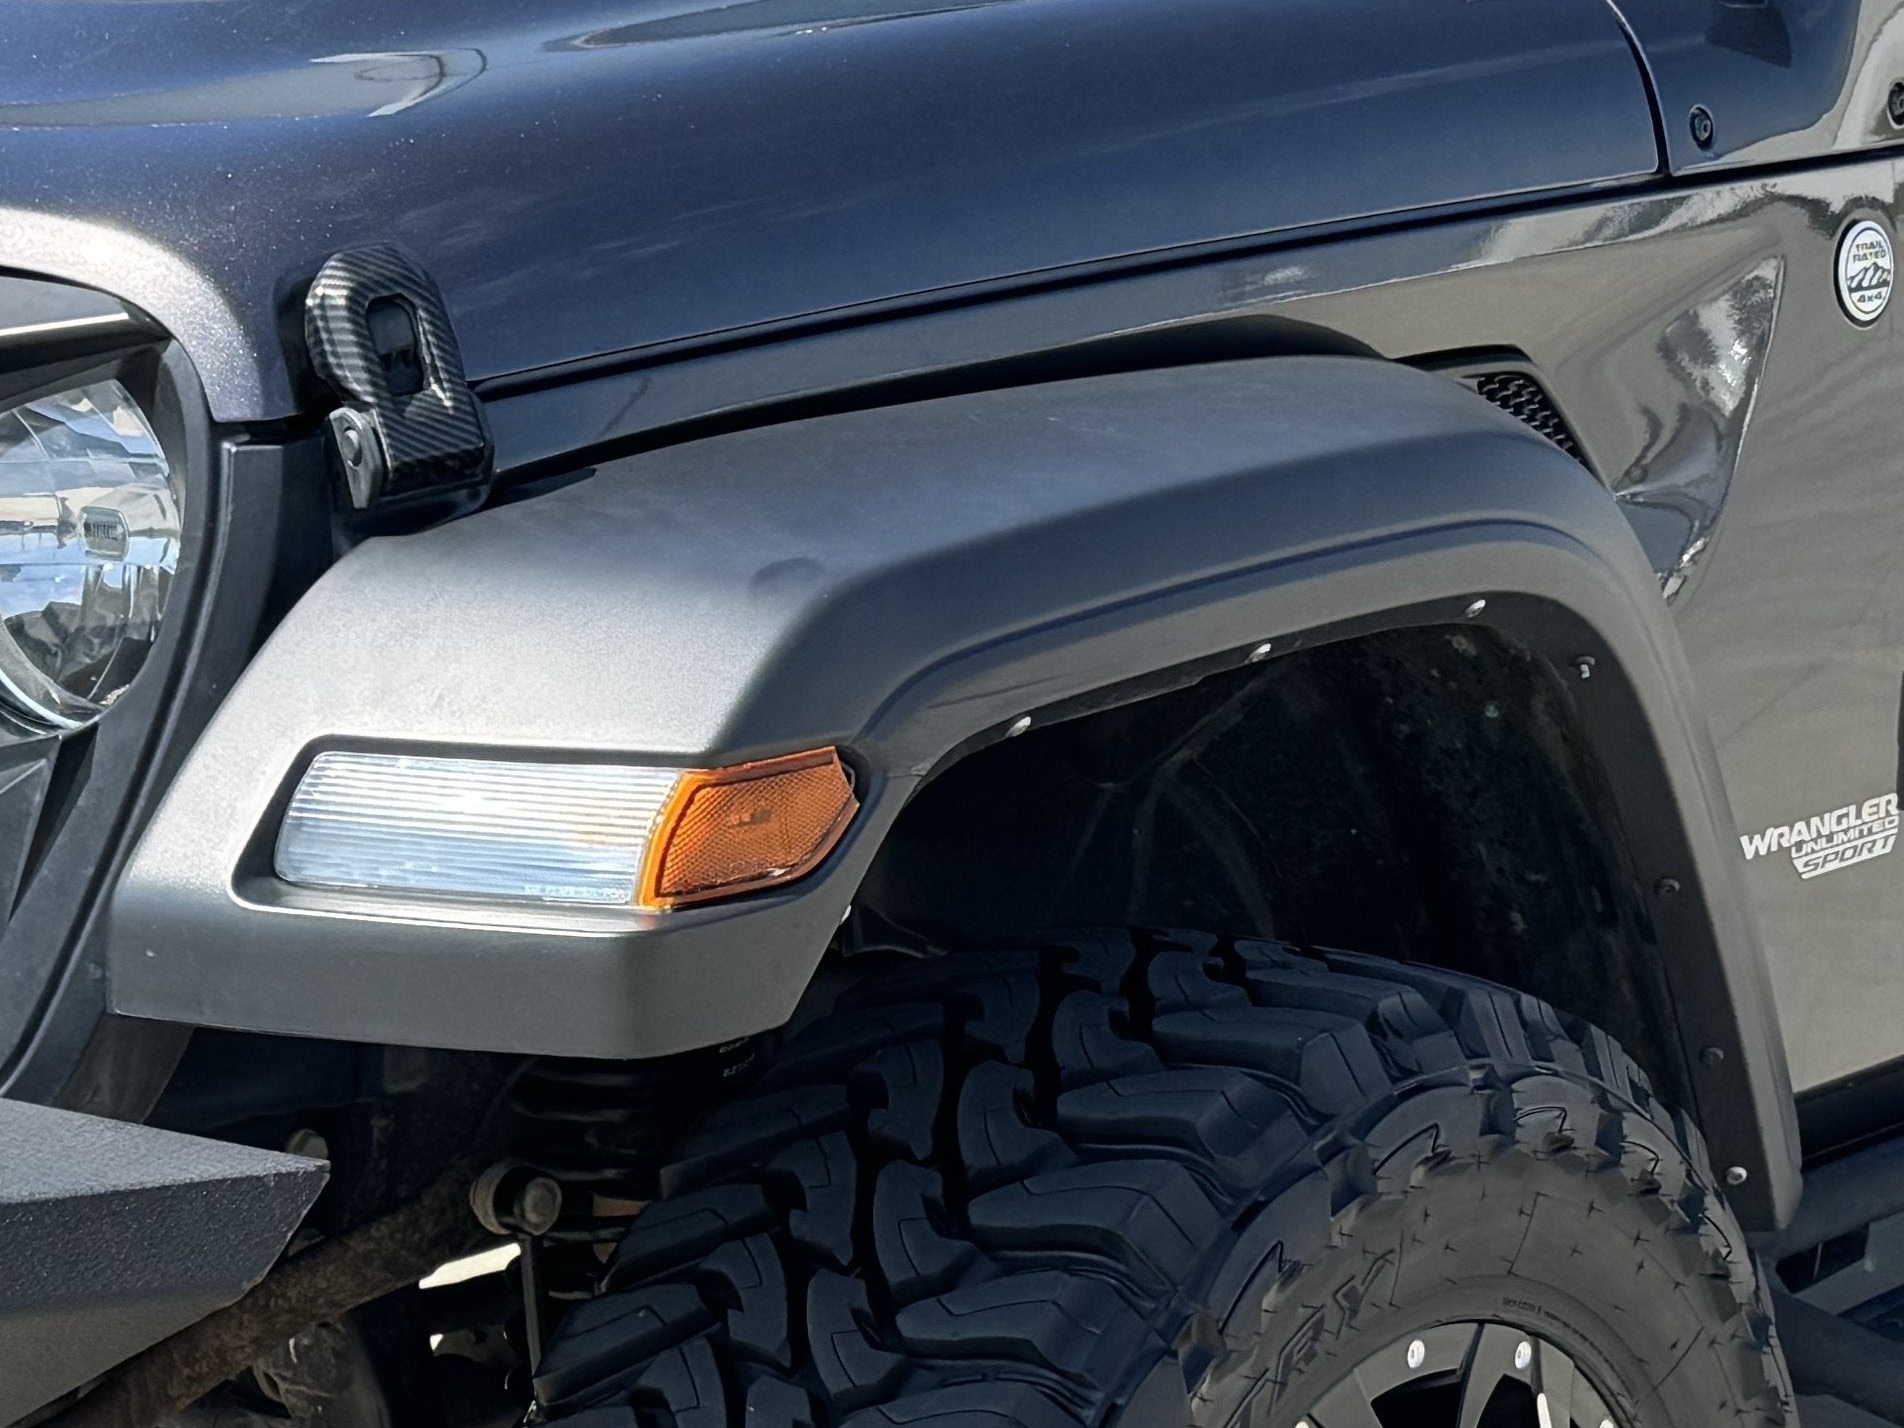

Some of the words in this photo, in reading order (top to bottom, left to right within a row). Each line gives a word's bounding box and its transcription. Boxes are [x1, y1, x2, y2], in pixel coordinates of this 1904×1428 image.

[1853, 250, 1887, 263] RATED
[1856, 240, 1884, 252] TRAIL
[1857, 292, 1882, 303] 4x4
[1739, 793, 1899, 860] WRANGLER
[1791, 816, 1899, 858] UNLIMITED
[1801, 834, 1897, 872] SPORT
